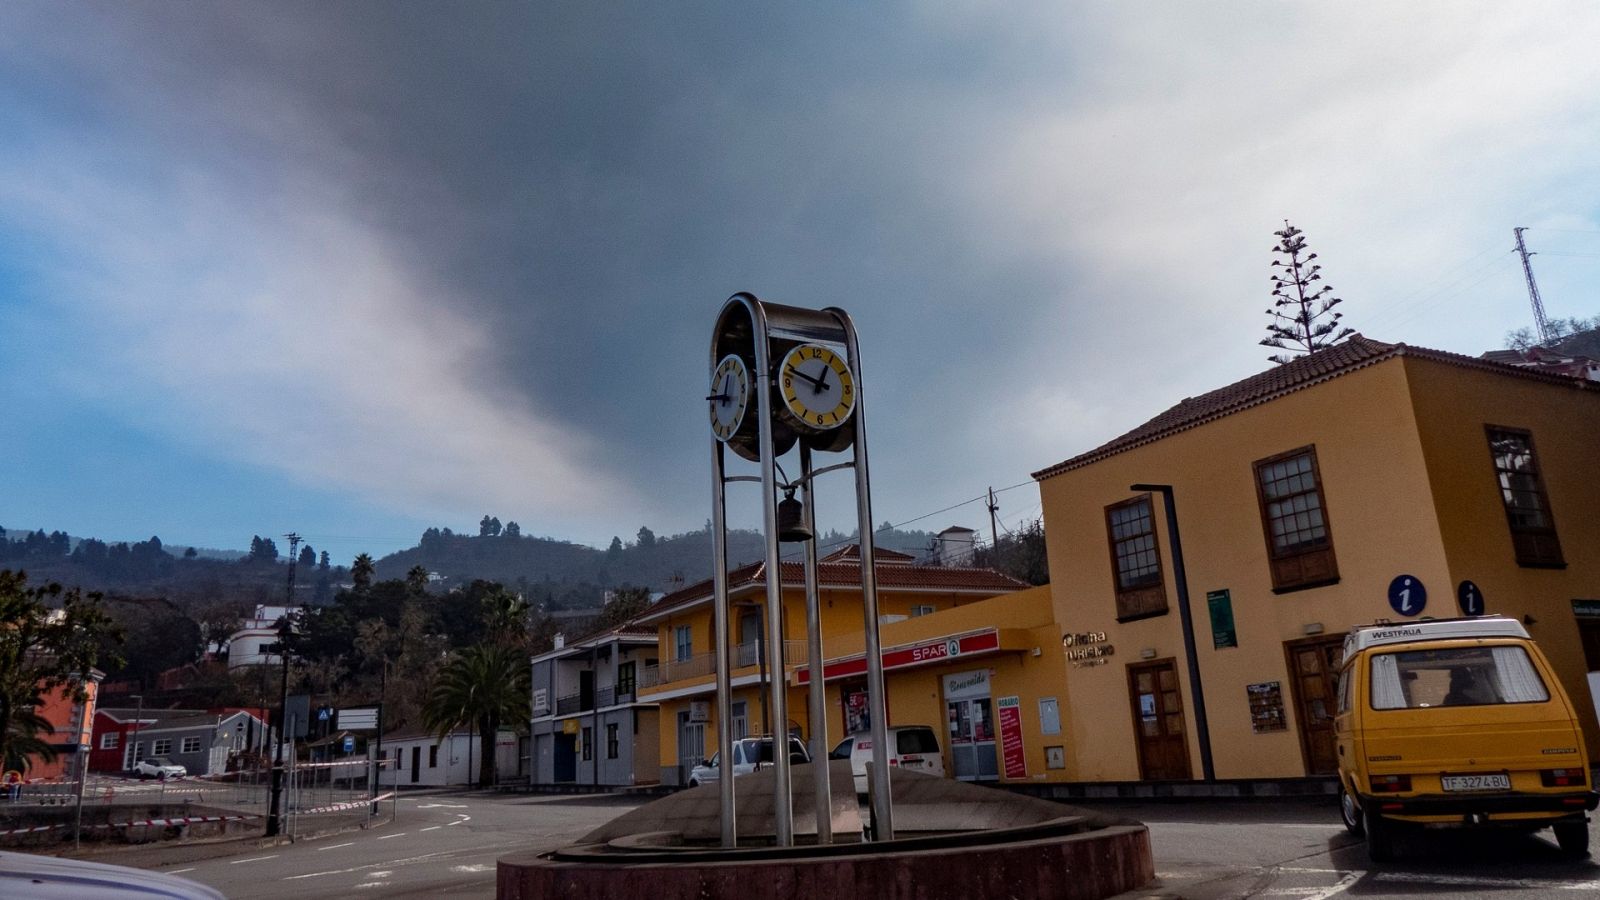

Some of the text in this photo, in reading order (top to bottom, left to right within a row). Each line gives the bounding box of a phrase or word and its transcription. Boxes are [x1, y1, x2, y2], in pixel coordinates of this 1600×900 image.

[812, 348, 823, 359] 12
[785, 378, 791, 388] 9
[844, 384, 851, 395] 3
[817, 414, 823, 424] 6
[1372, 628, 1422, 640] WESTFALIA
[912, 643, 948, 661] SPAR
[1443, 776, 1509, 790] TF-3274-BU
